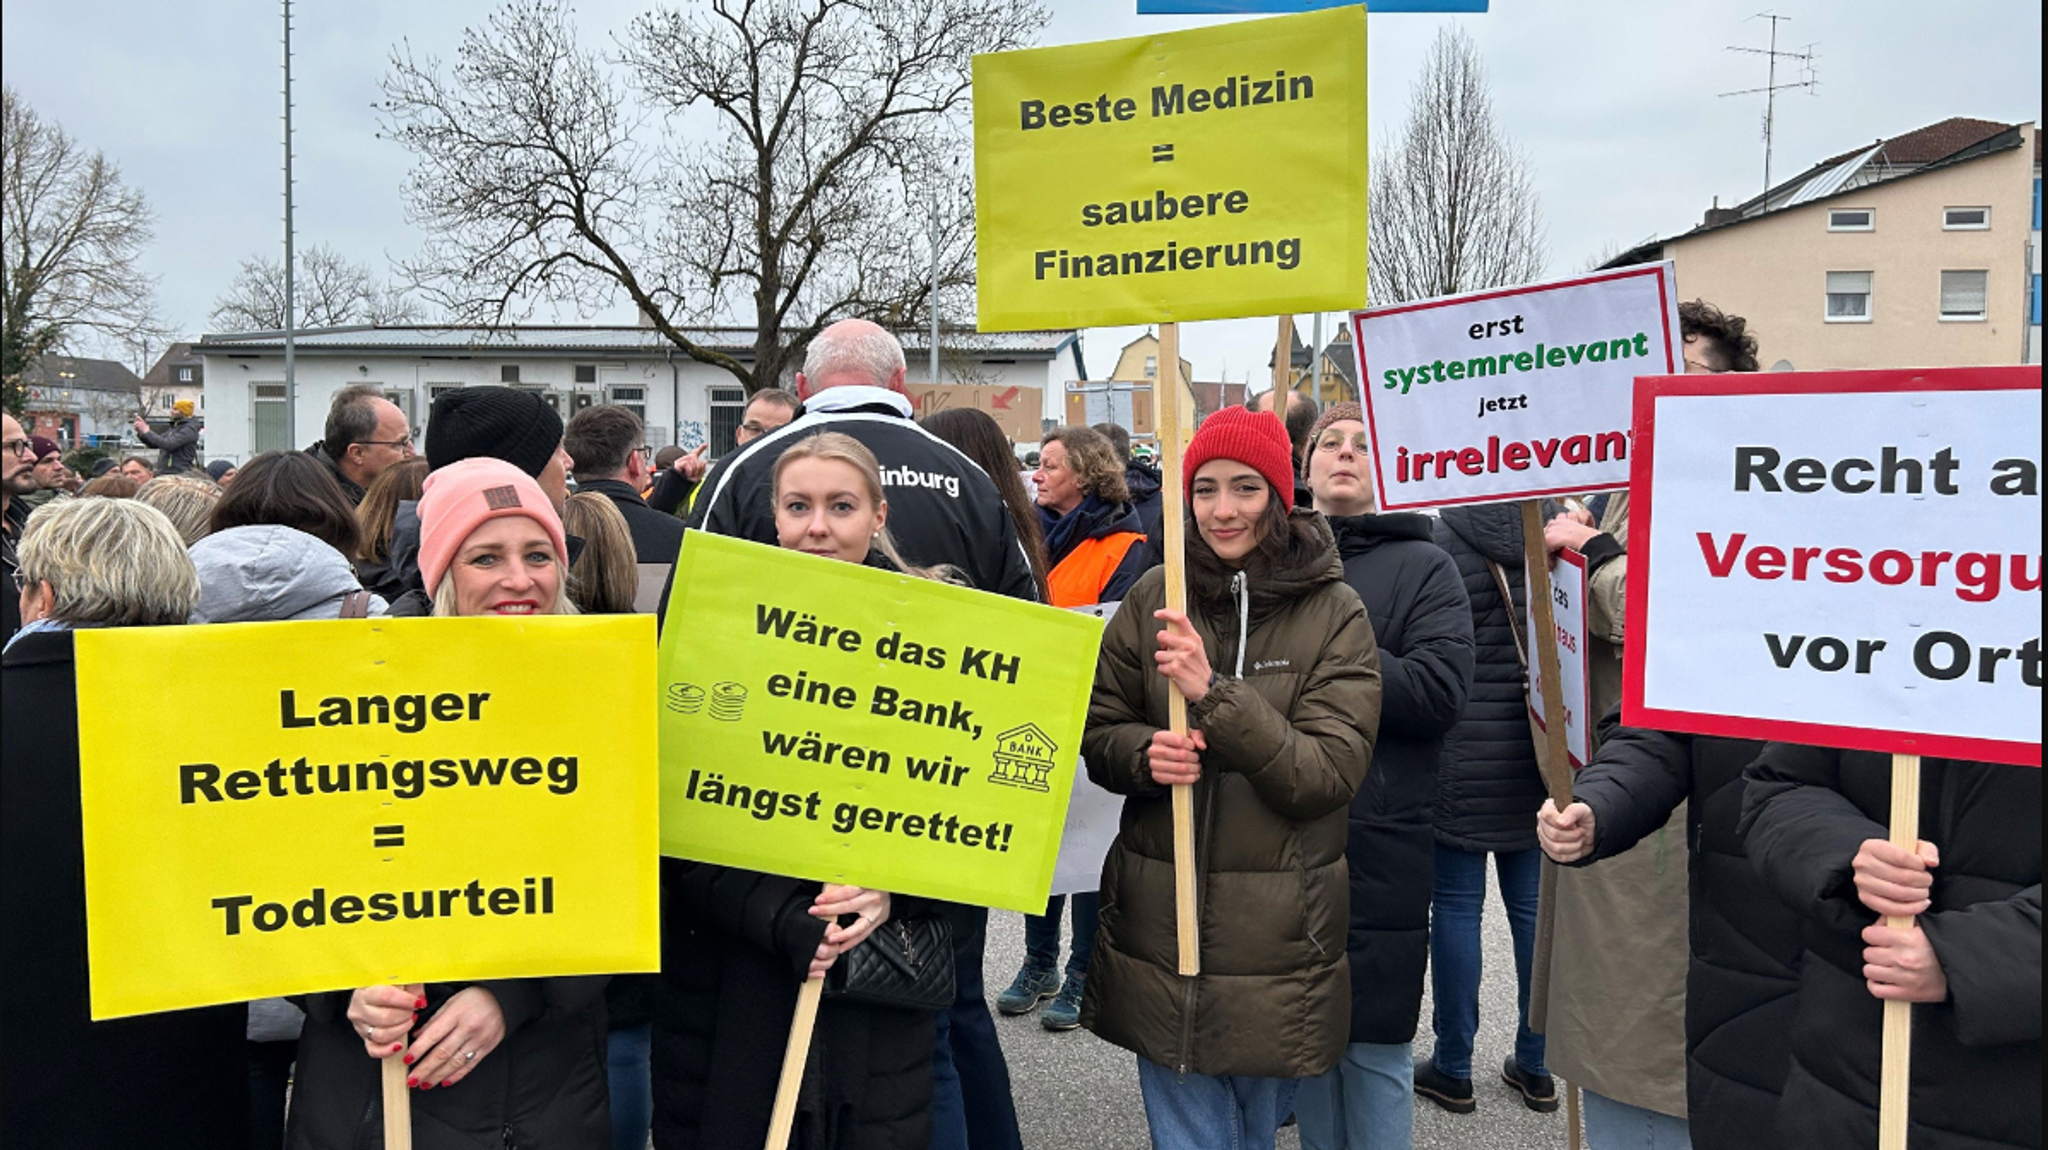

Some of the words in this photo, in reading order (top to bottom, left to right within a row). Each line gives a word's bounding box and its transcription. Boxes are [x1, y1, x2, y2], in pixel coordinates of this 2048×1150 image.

[1020, 94, 1137, 131] Beste
[1151, 70, 1314, 118] Medizin
[1153, 143, 1175, 163] =
[1082, 190, 1249, 227] saubere
[1035, 238, 1302, 280] Finanzierung
[1468, 314, 1524, 340] erst
[1383, 332, 1649, 391] systemrelevant
[1477, 393, 1528, 418] jetzt
[1396, 429, 1631, 482] irrelevan
[1734, 446, 1960, 496] Recht
[1697, 532, 2042, 603] Versorgu
[755, 604, 862, 652] Wäre
[875, 631, 946, 669] das
[959, 646, 1021, 684] KH
[1764, 633, 1887, 674] vor
[1913, 631, 2042, 688] Ort
[280, 689, 491, 734] Langer
[767, 670, 857, 710] eine
[870, 685, 983, 741] Bank,
[762, 730, 891, 774] wären
[906, 755, 970, 788] wir
[1009, 741, 1043, 757] BANK
[179, 756, 578, 804] Rettungsweg
[685, 769, 822, 821] längst
[832, 802, 1013, 852] gerettet!
[373, 825, 405, 848] =
[211, 876, 554, 936] Todesurteil
